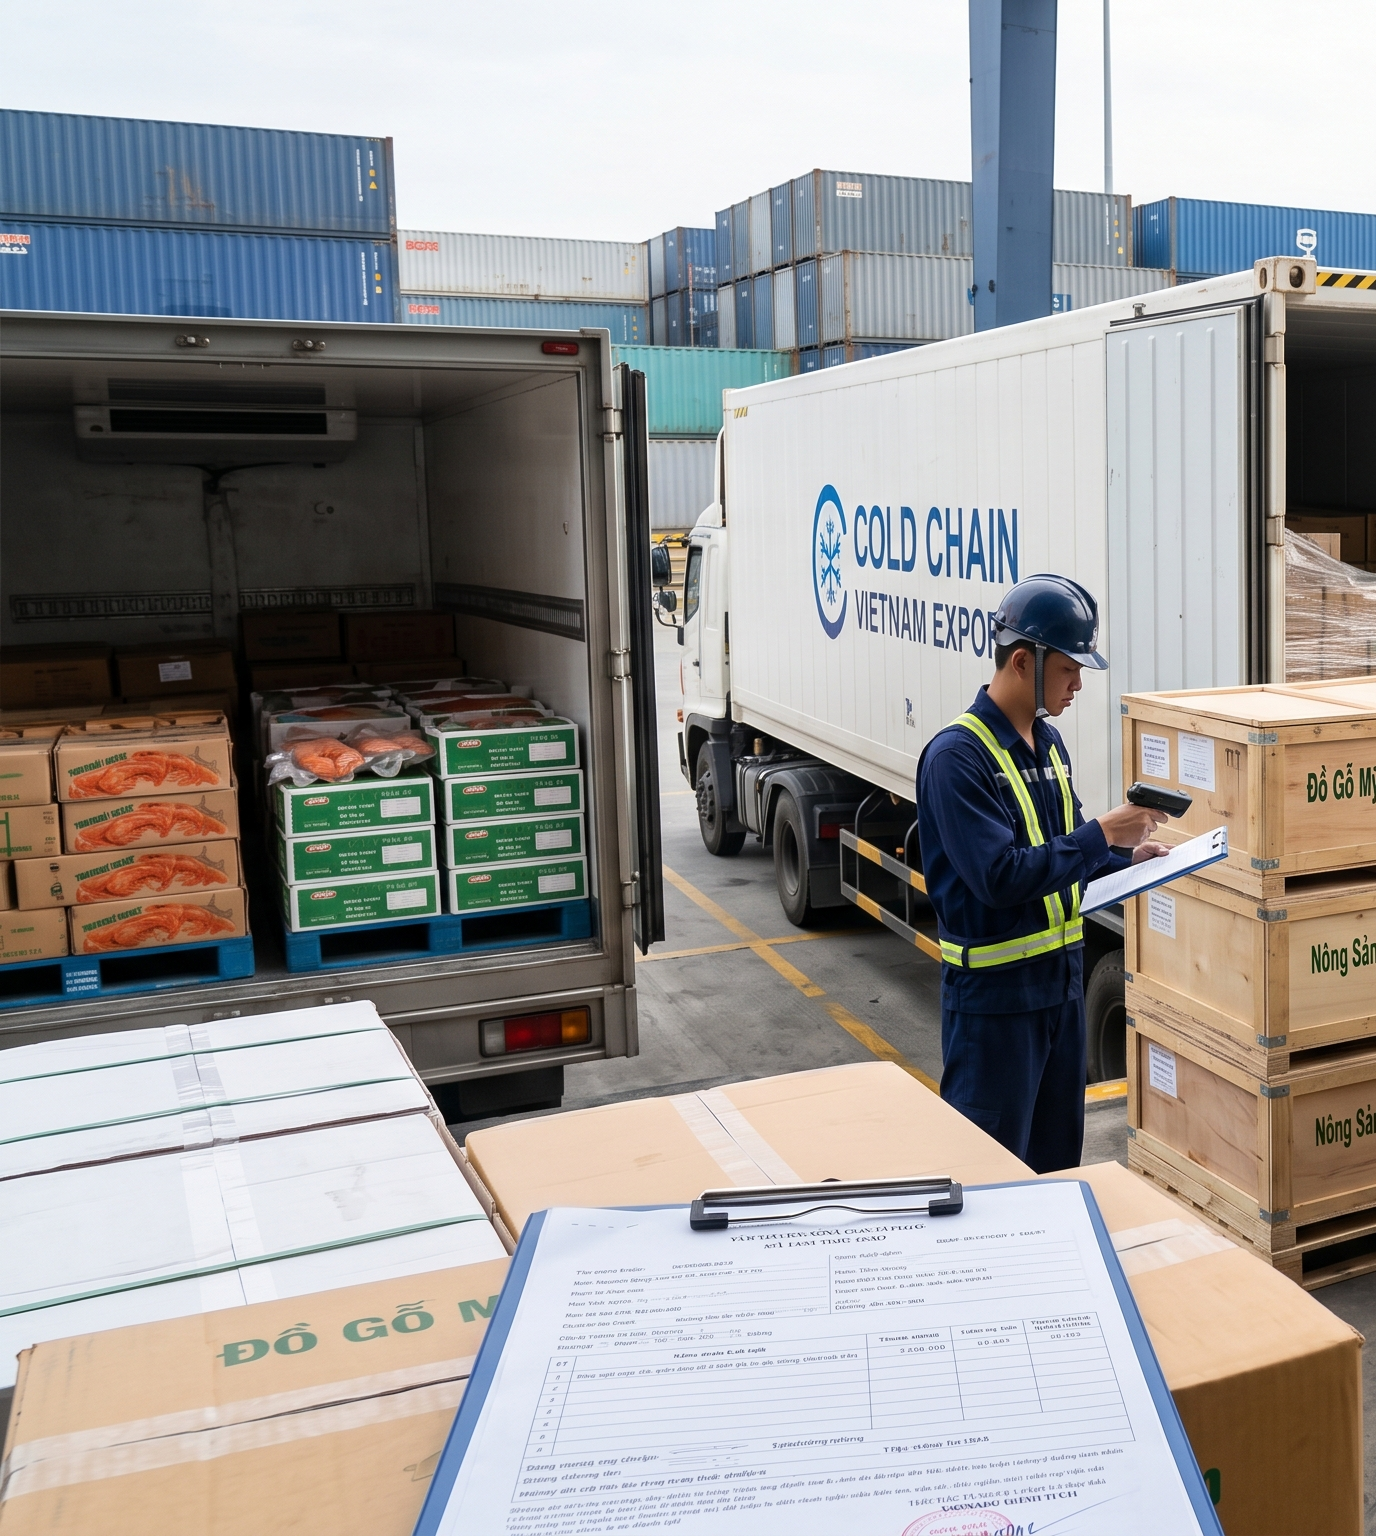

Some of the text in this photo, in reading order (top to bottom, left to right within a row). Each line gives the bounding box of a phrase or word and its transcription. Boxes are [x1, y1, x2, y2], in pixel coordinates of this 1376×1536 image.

[854, 505, 1019, 584] COLD CHAIN
[855, 589, 926, 644] VIETNAM
[1307, 765, 1328, 803] Đồ
[1333, 762, 1354, 800] Gỗ
[1311, 942, 1348, 977] Nông
[1315, 1114, 1352, 1148] Nông
[216, 1322, 318, 1368] ĐỒ
[343, 1299, 435, 1343] GỖ
